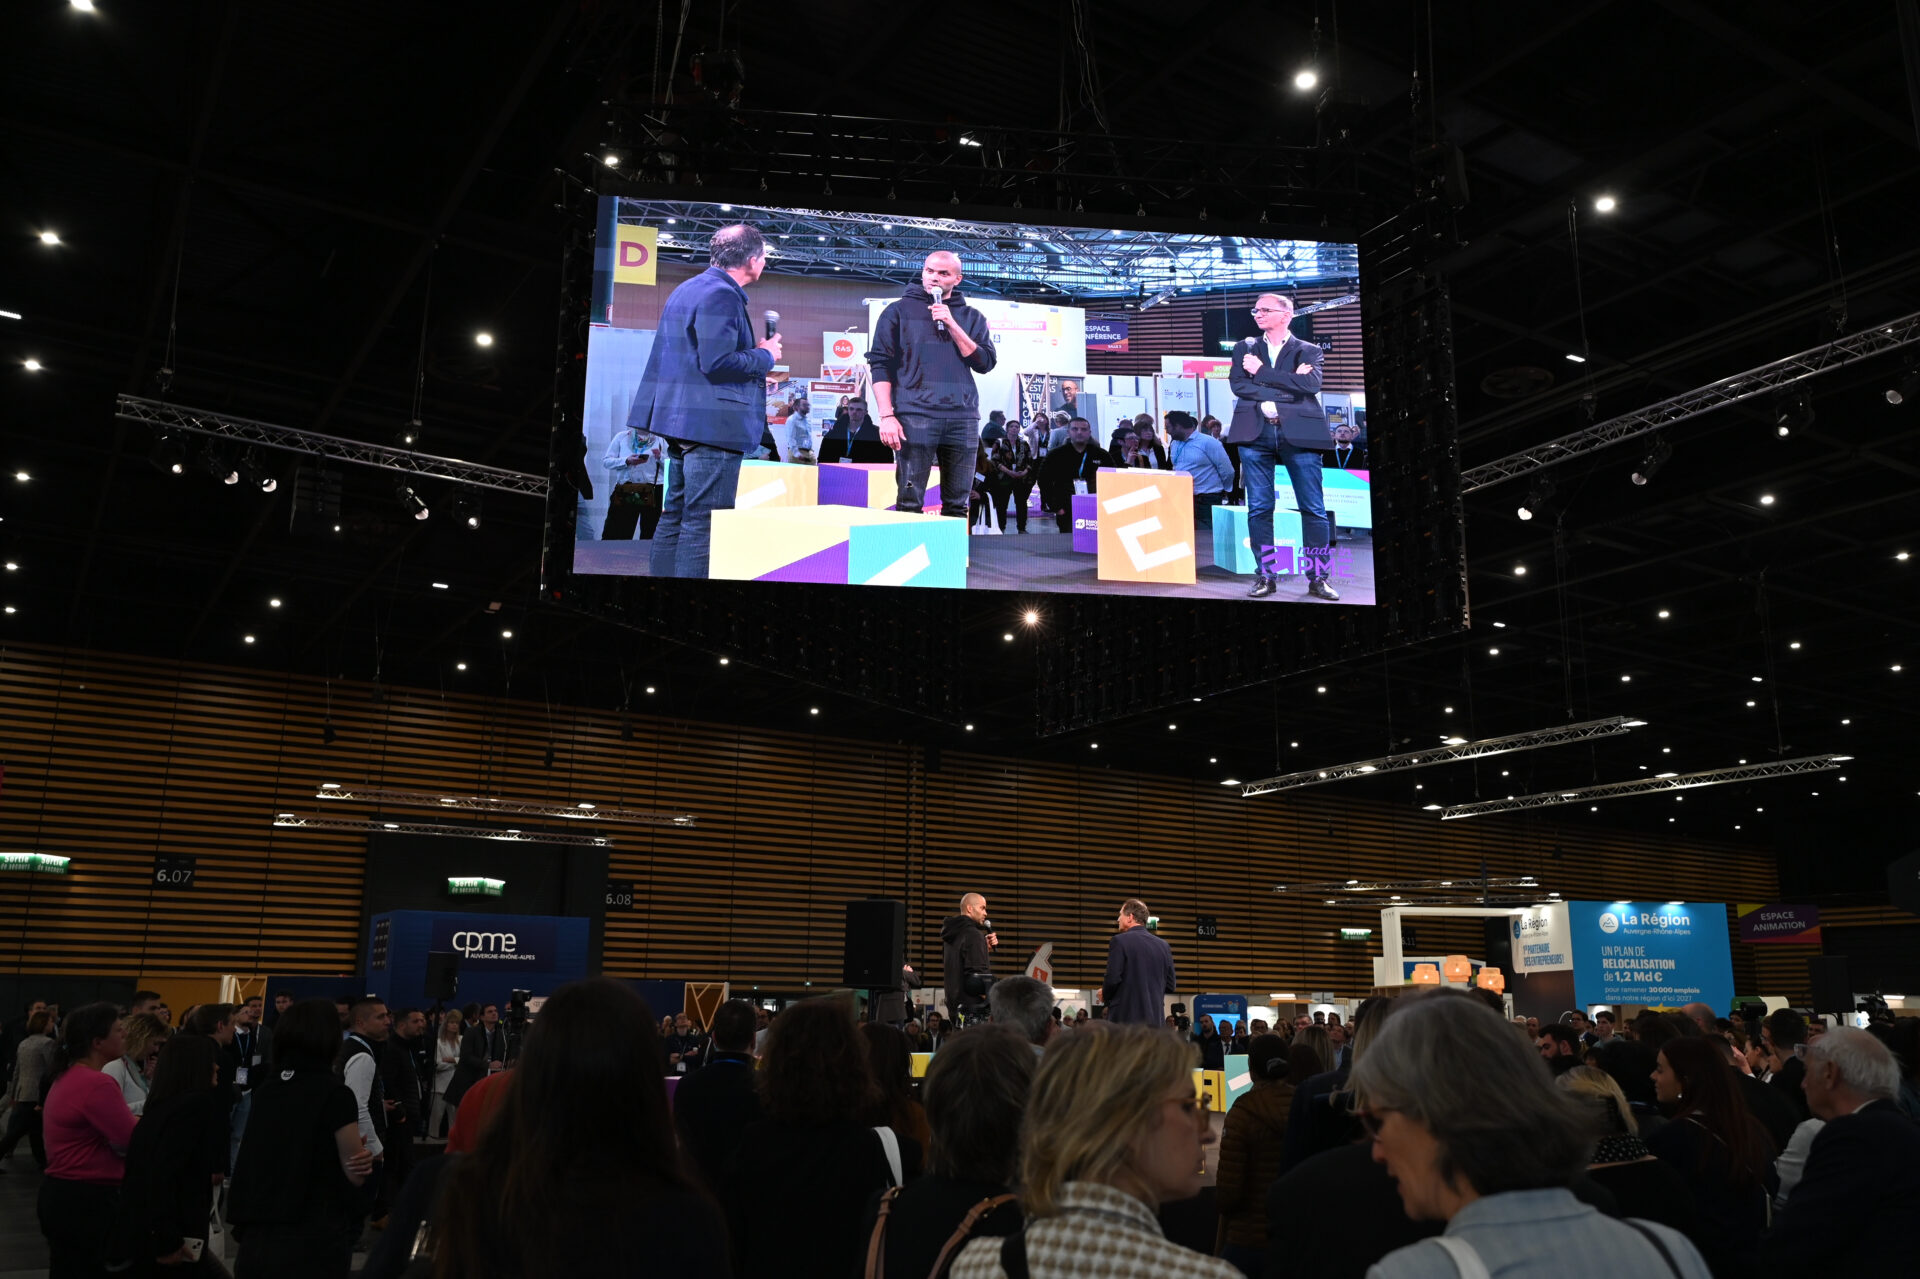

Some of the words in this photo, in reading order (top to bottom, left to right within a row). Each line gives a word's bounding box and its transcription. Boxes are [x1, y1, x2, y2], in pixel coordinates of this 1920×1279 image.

[619, 240, 649, 267] D
[1297, 556, 1354, 578] PME
[156, 869, 192, 883] 6.07
[605, 893, 632, 906] 6.08
[1621, 912, 1638, 925] La
[1640, 912, 1691, 928] Région
[1760, 911, 1795, 921] ESPACE
[1521, 919, 1528, 930] La
[1528, 917, 1548, 930] Région
[1753, 921, 1806, 932] ANIMATION
[452, 931, 517, 959] cpme
[1601, 945, 1613, 957] UN
[1614, 945, 1634, 957] PLAN
[1635, 946, 1646, 957] DE
[470, 953, 536, 961] AUVERGNE-RHÔNE-ALPES
[1602, 958, 1676, 970] RELOCALISATION
[1603, 971, 1614, 982] de
[1614, 971, 1632, 983] 1,2
